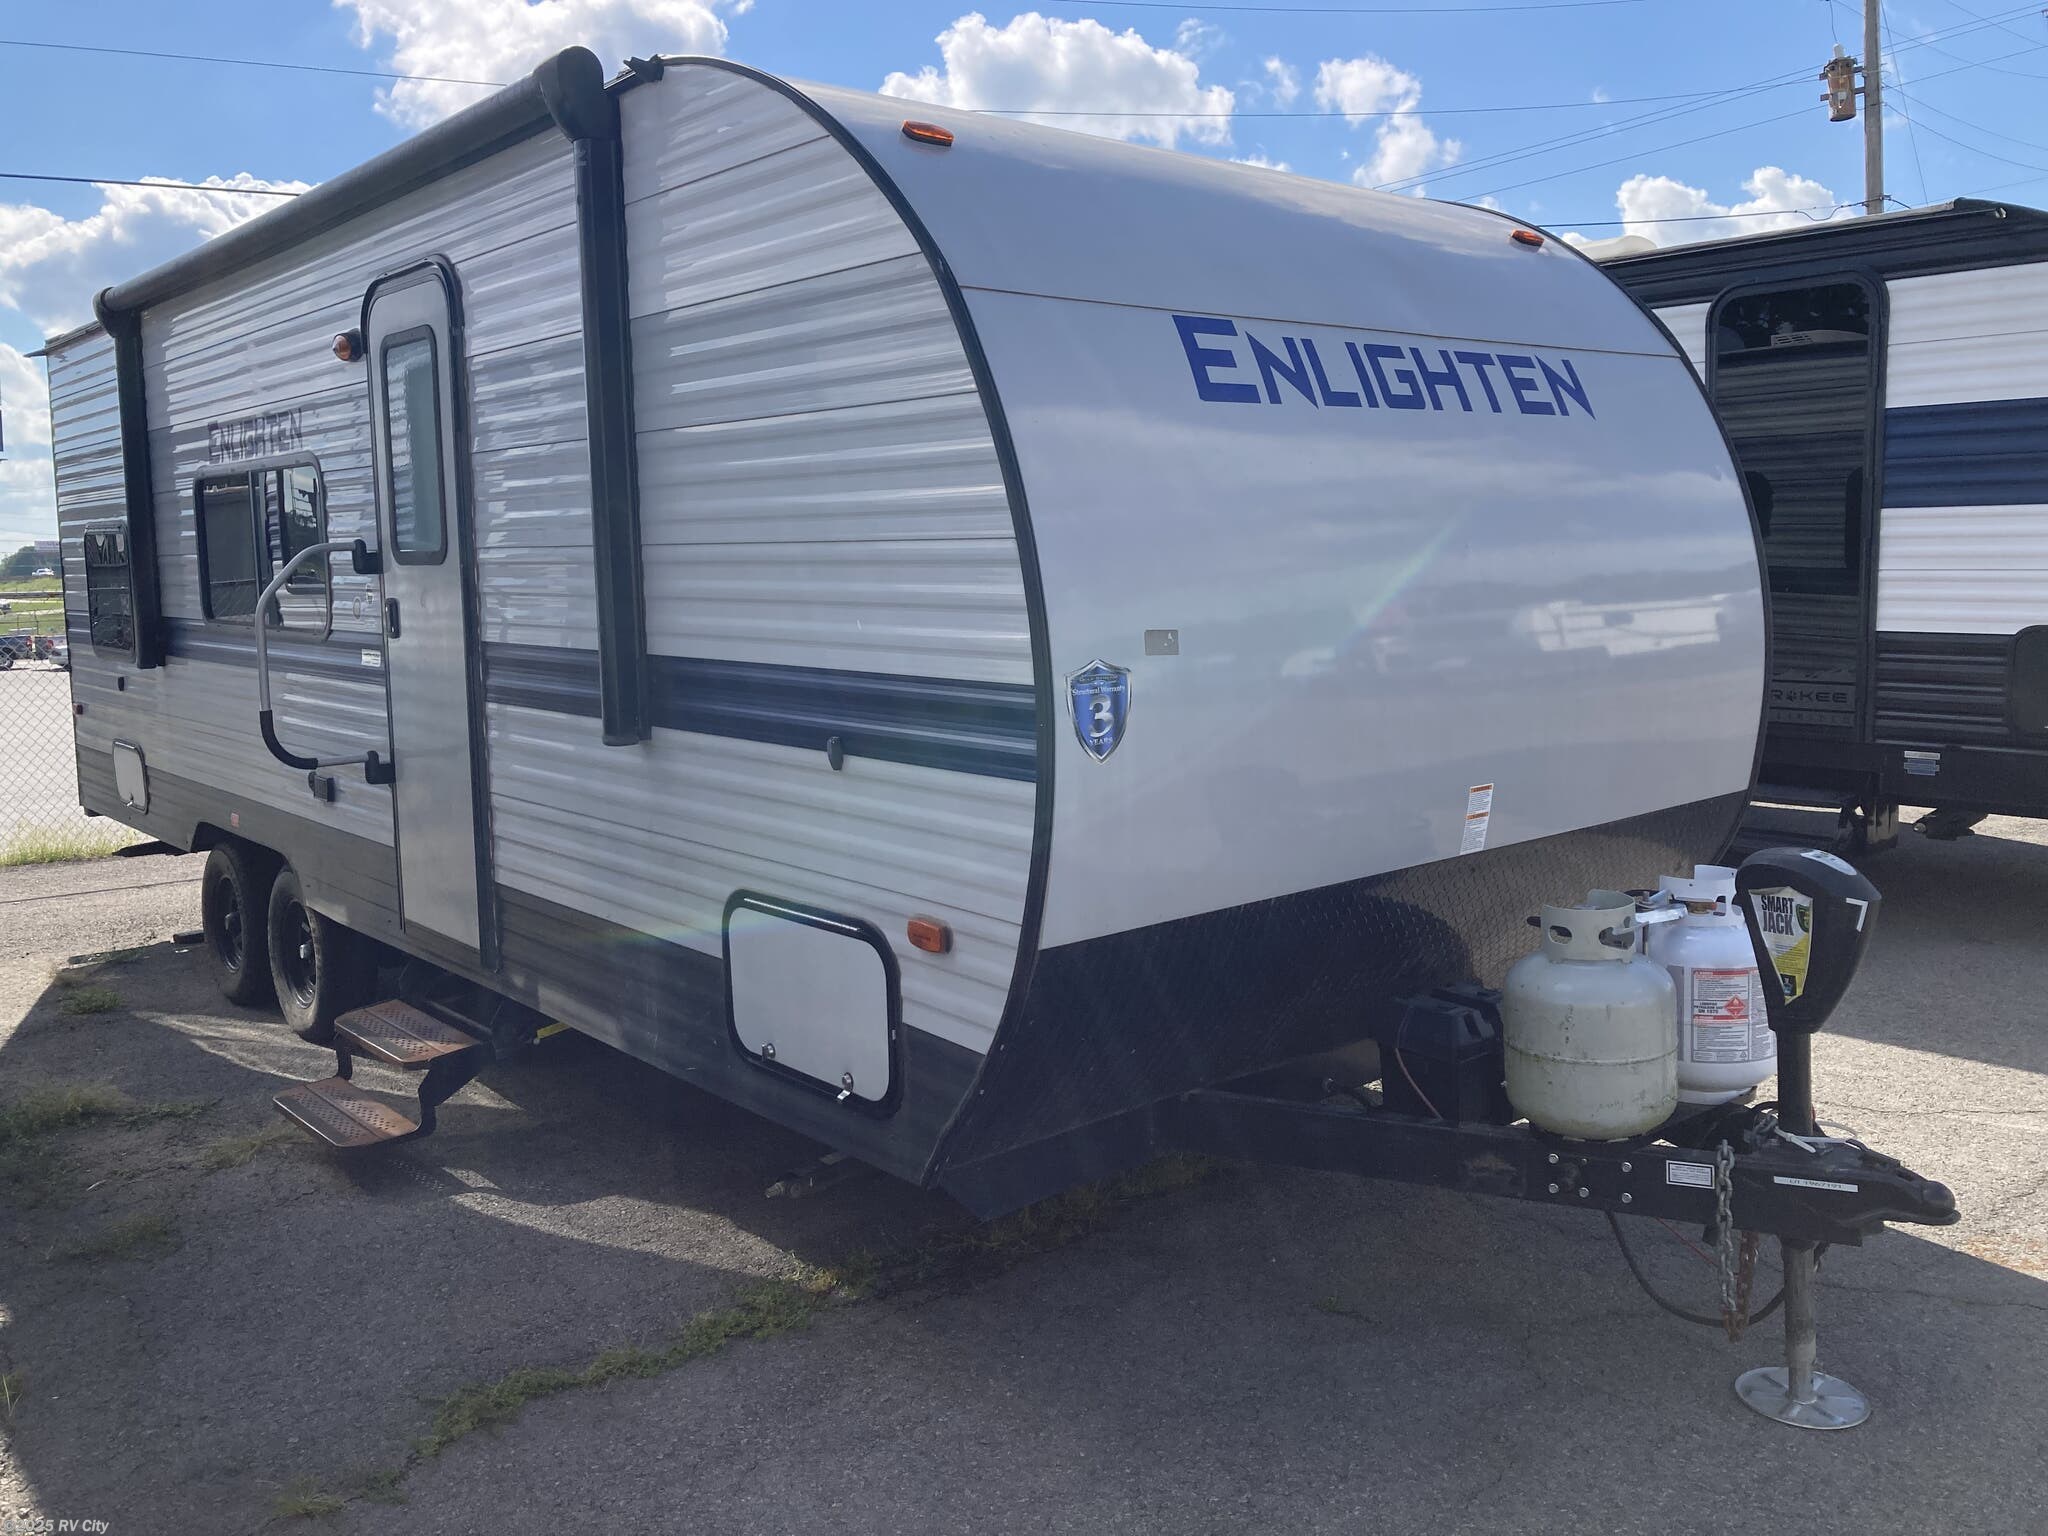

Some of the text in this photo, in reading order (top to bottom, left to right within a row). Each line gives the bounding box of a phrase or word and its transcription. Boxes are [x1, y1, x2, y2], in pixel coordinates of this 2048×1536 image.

[1172, 315, 1596, 421] ENLIGHTEN
[208, 407, 303, 465] ENLIGHTEN
[1088, 694, 1115, 738] 3
[1761, 895, 1794, 914] SMART
[1763, 911, 1794, 936] JACK
